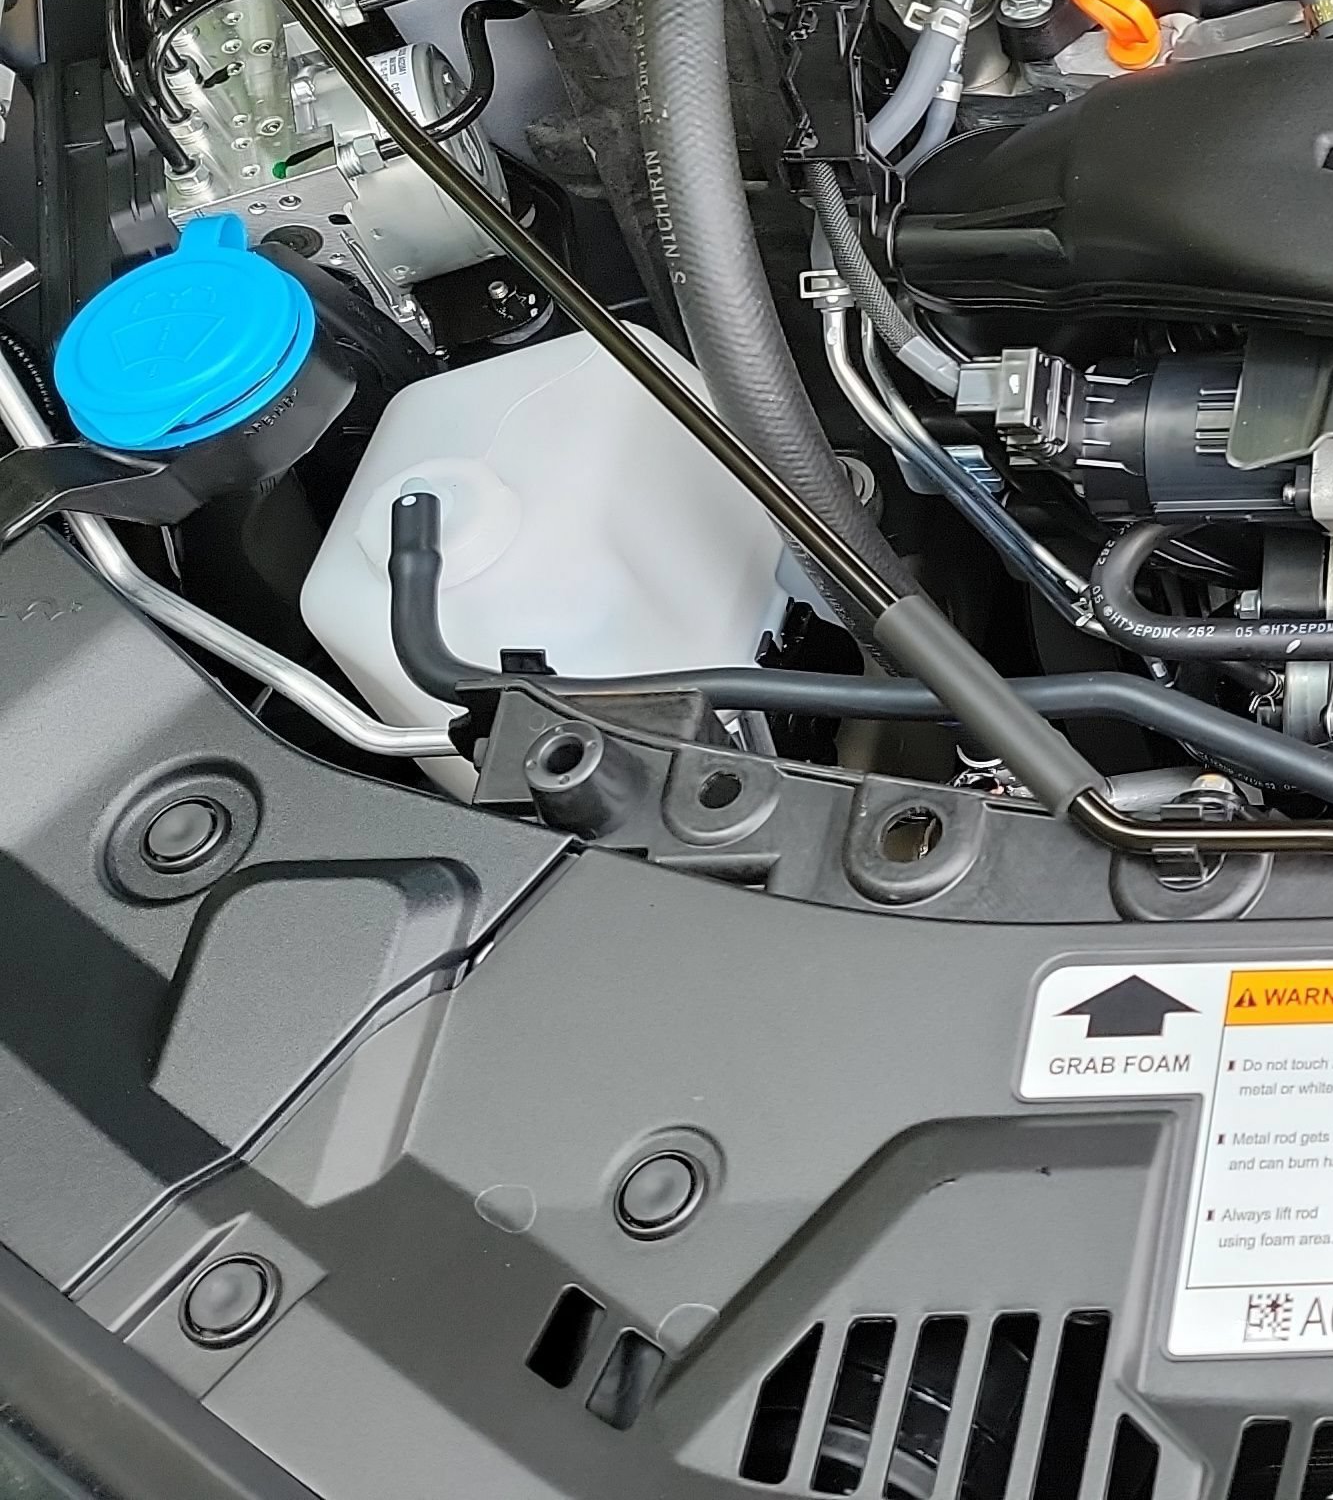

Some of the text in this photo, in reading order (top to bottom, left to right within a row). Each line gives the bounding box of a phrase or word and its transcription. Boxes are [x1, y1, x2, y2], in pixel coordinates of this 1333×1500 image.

[1187, 626, 1215, 638] 262
[1235, 626, 1253, 638] 05
[1049, 1055, 1190, 1076] GRAB FOAM
[1242, 1059, 1260, 1071] Do
[1265, 1059, 1288, 1071] not
[1291, 1057, 1328, 1071] touch
[1239, 1082, 1277, 1095] metal
[1281, 1085, 1295, 1095] or
[1299, 1081, 1333, 1094] white
[1233, 1132, 1270, 1145] Metal
[1274, 1132, 1296, 1145] rod
[1300, 1132, 1330, 1148] gets
[1229, 1157, 1256, 1171] and
[1259, 1159, 1284, 1170] can
[1288, 1156, 1319, 1169] burn
[1221, 1207, 1319, 1223] Always lift rod
[1219, 1233, 1256, 1250] using
[1259, 1233, 1294, 1247] foam
